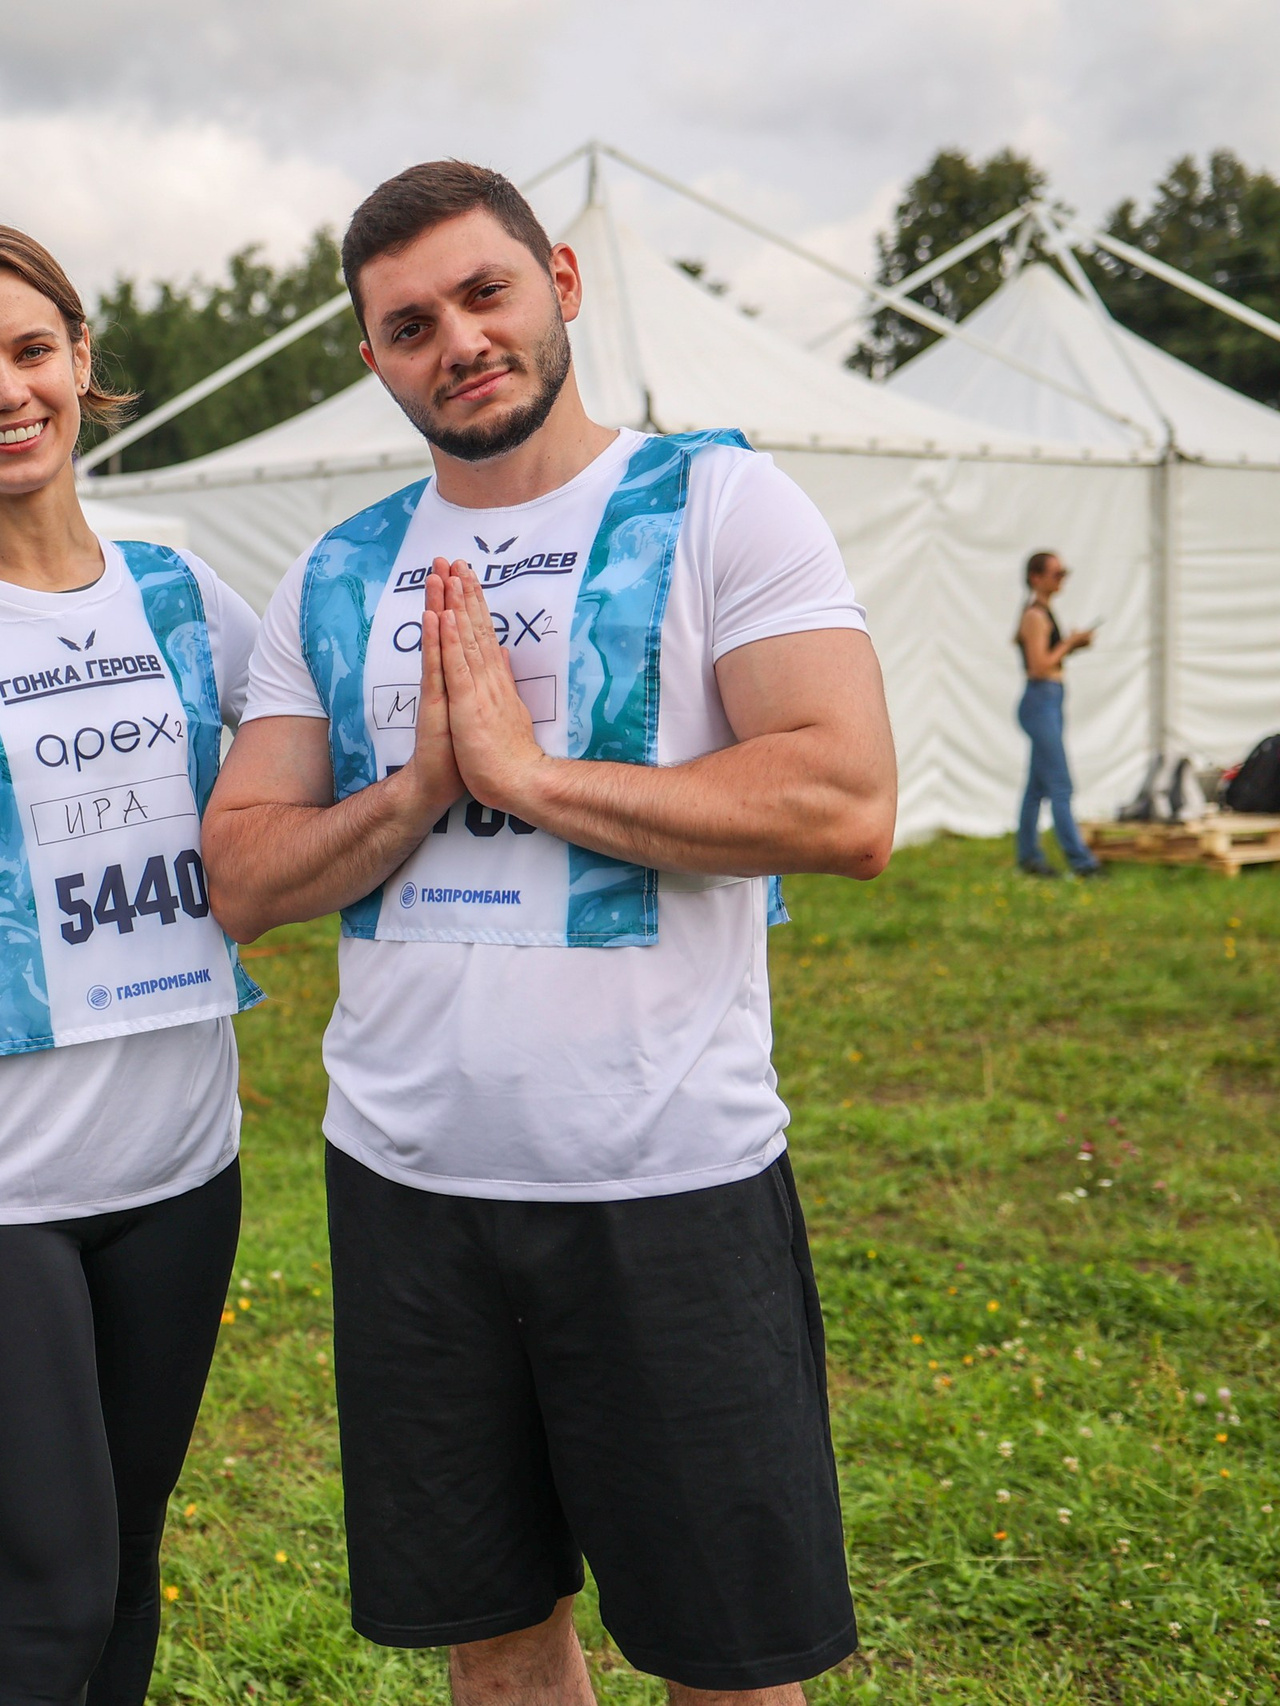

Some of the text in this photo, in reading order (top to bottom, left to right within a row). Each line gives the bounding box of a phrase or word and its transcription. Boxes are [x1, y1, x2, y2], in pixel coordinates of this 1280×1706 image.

[484, 551, 579, 582] ГЕРОЕВ
[393, 608, 546, 653] aex
[85, 654, 162, 680] ГЕРОЕВ
[65, 790, 148, 835] ИРА
[55, 848, 210, 945] 5440
[421, 886, 522, 905] ГАЗПРОМБАНК
[116, 969, 212, 1000] ГАЗПРОМБАНК
